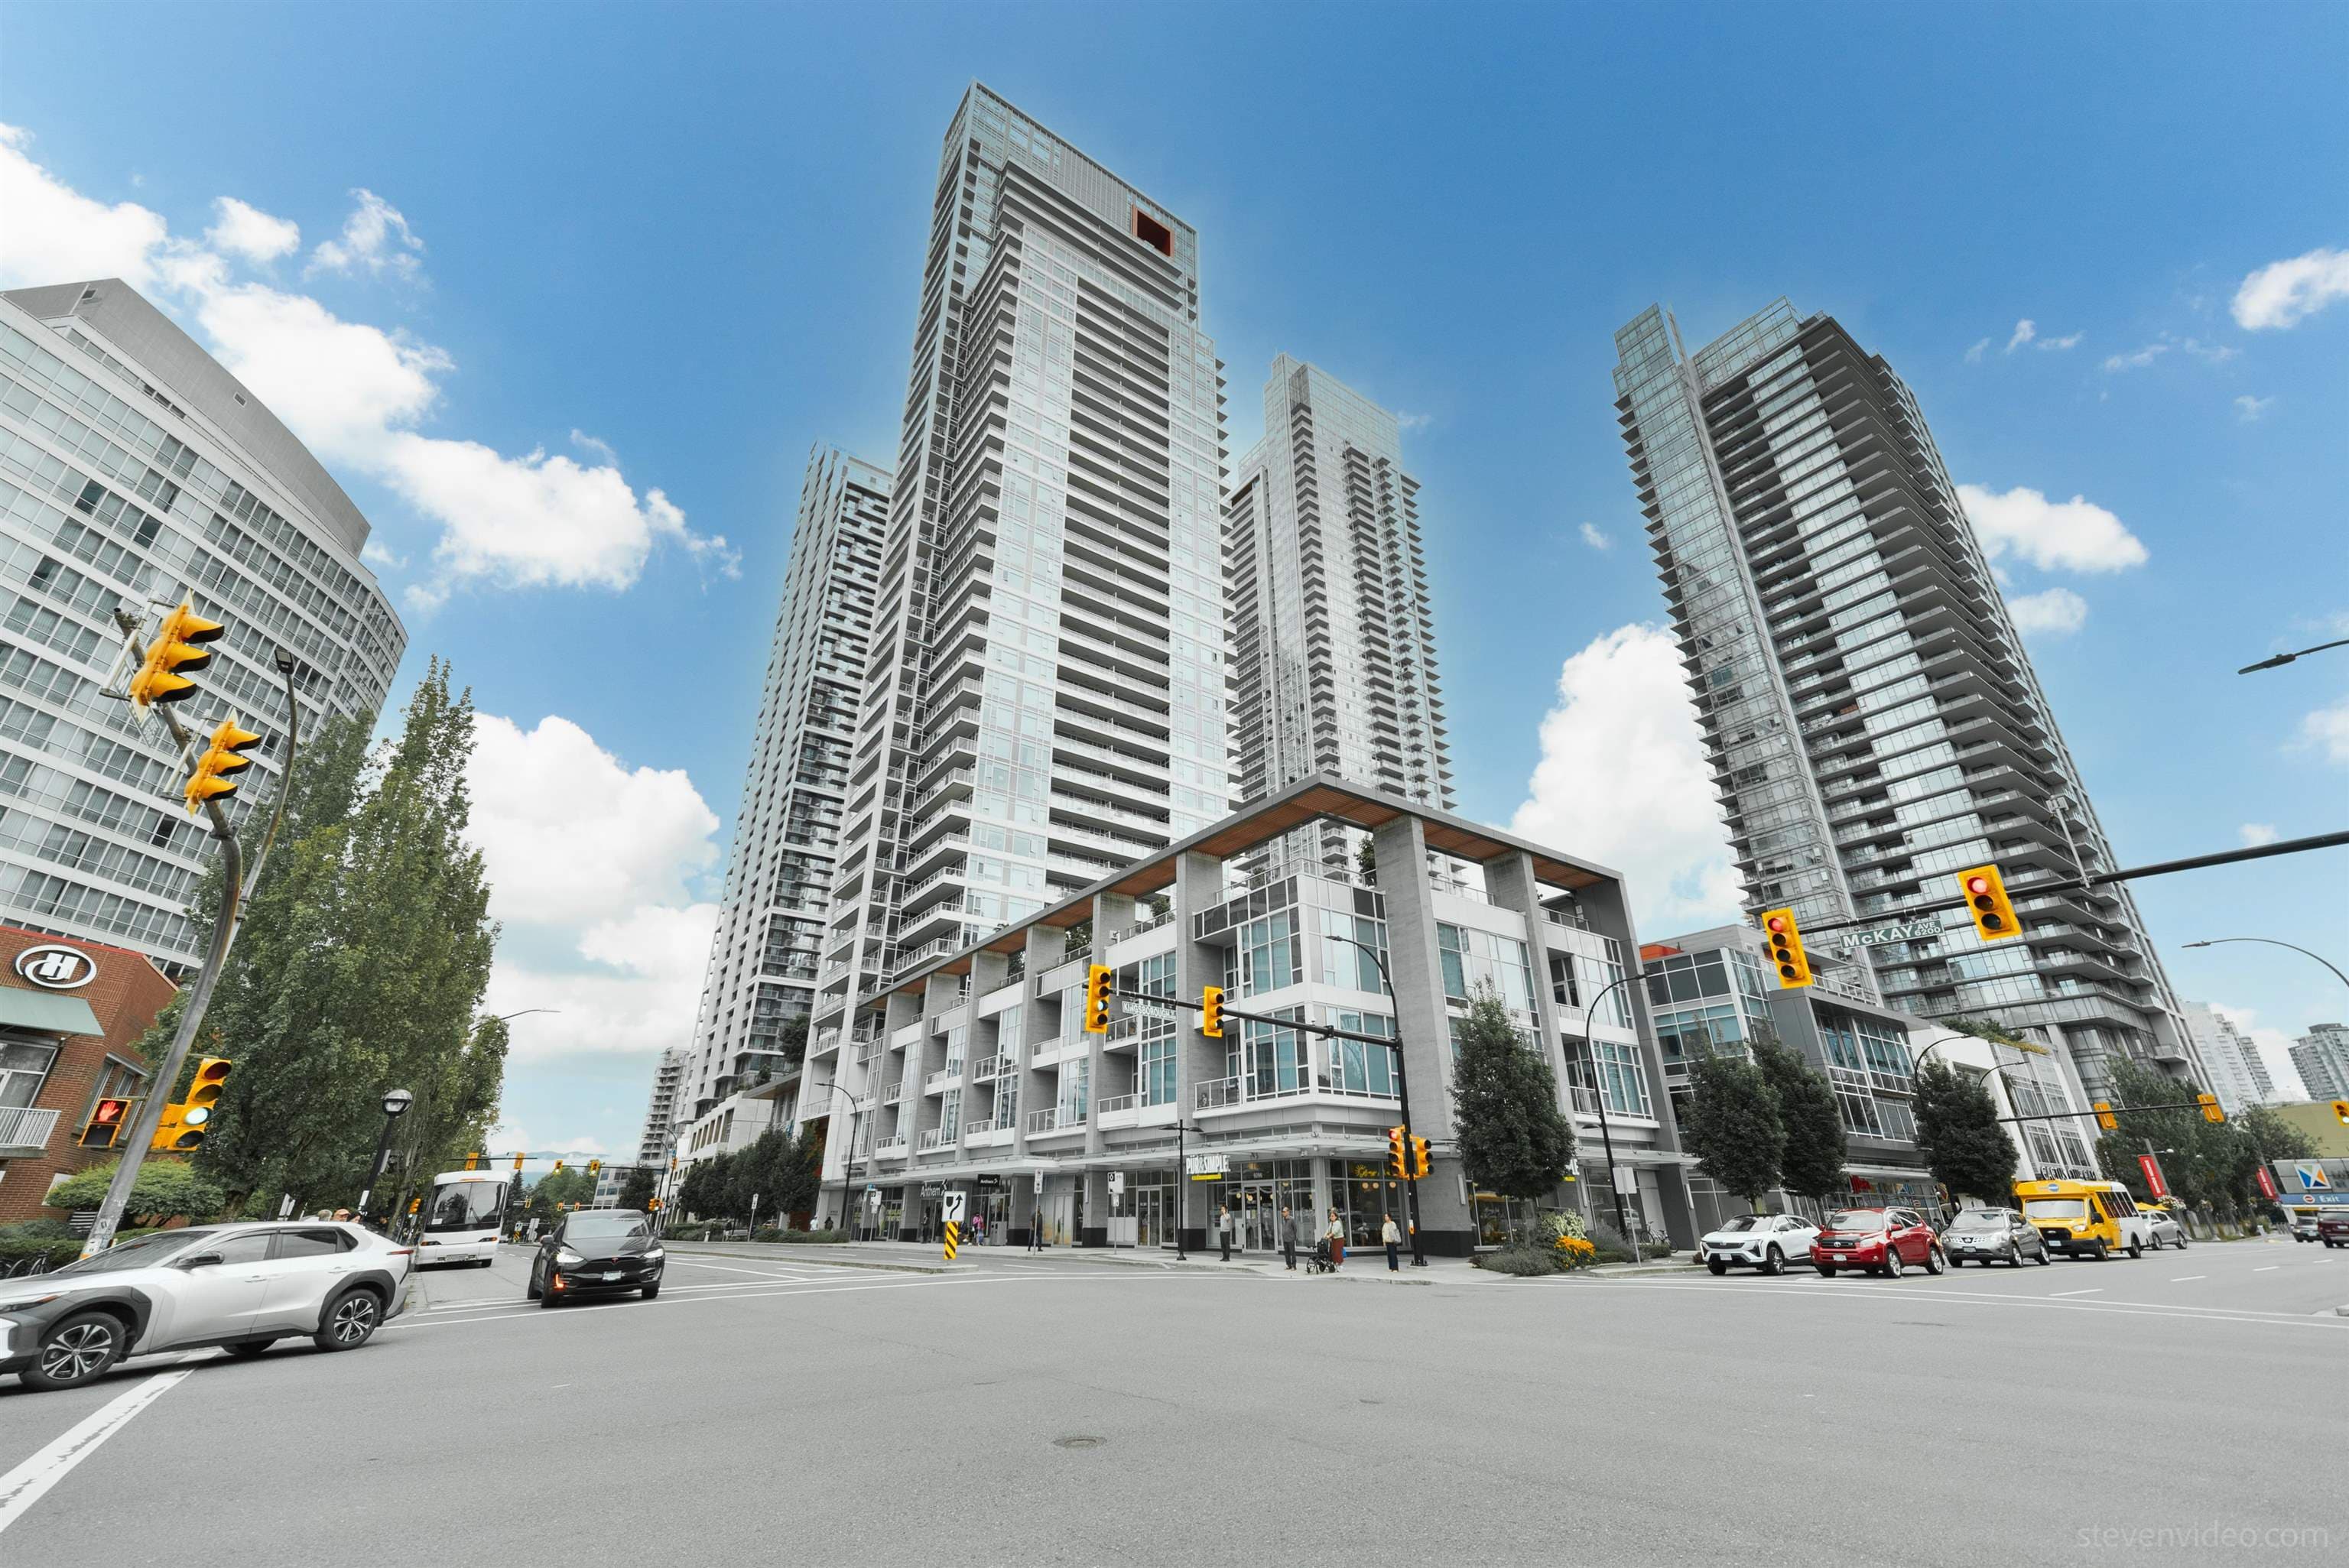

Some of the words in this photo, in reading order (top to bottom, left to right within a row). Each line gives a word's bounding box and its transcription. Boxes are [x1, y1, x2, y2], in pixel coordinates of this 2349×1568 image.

[1917, 921, 1935, 930] AVE
[1843, 925, 1912, 947] McKAY
[1915, 926, 1941, 937] 6200
[1123, 1002, 1170, 1018] KINGSBOROUGH
[2319, 1195, 2340, 1203] Exit
